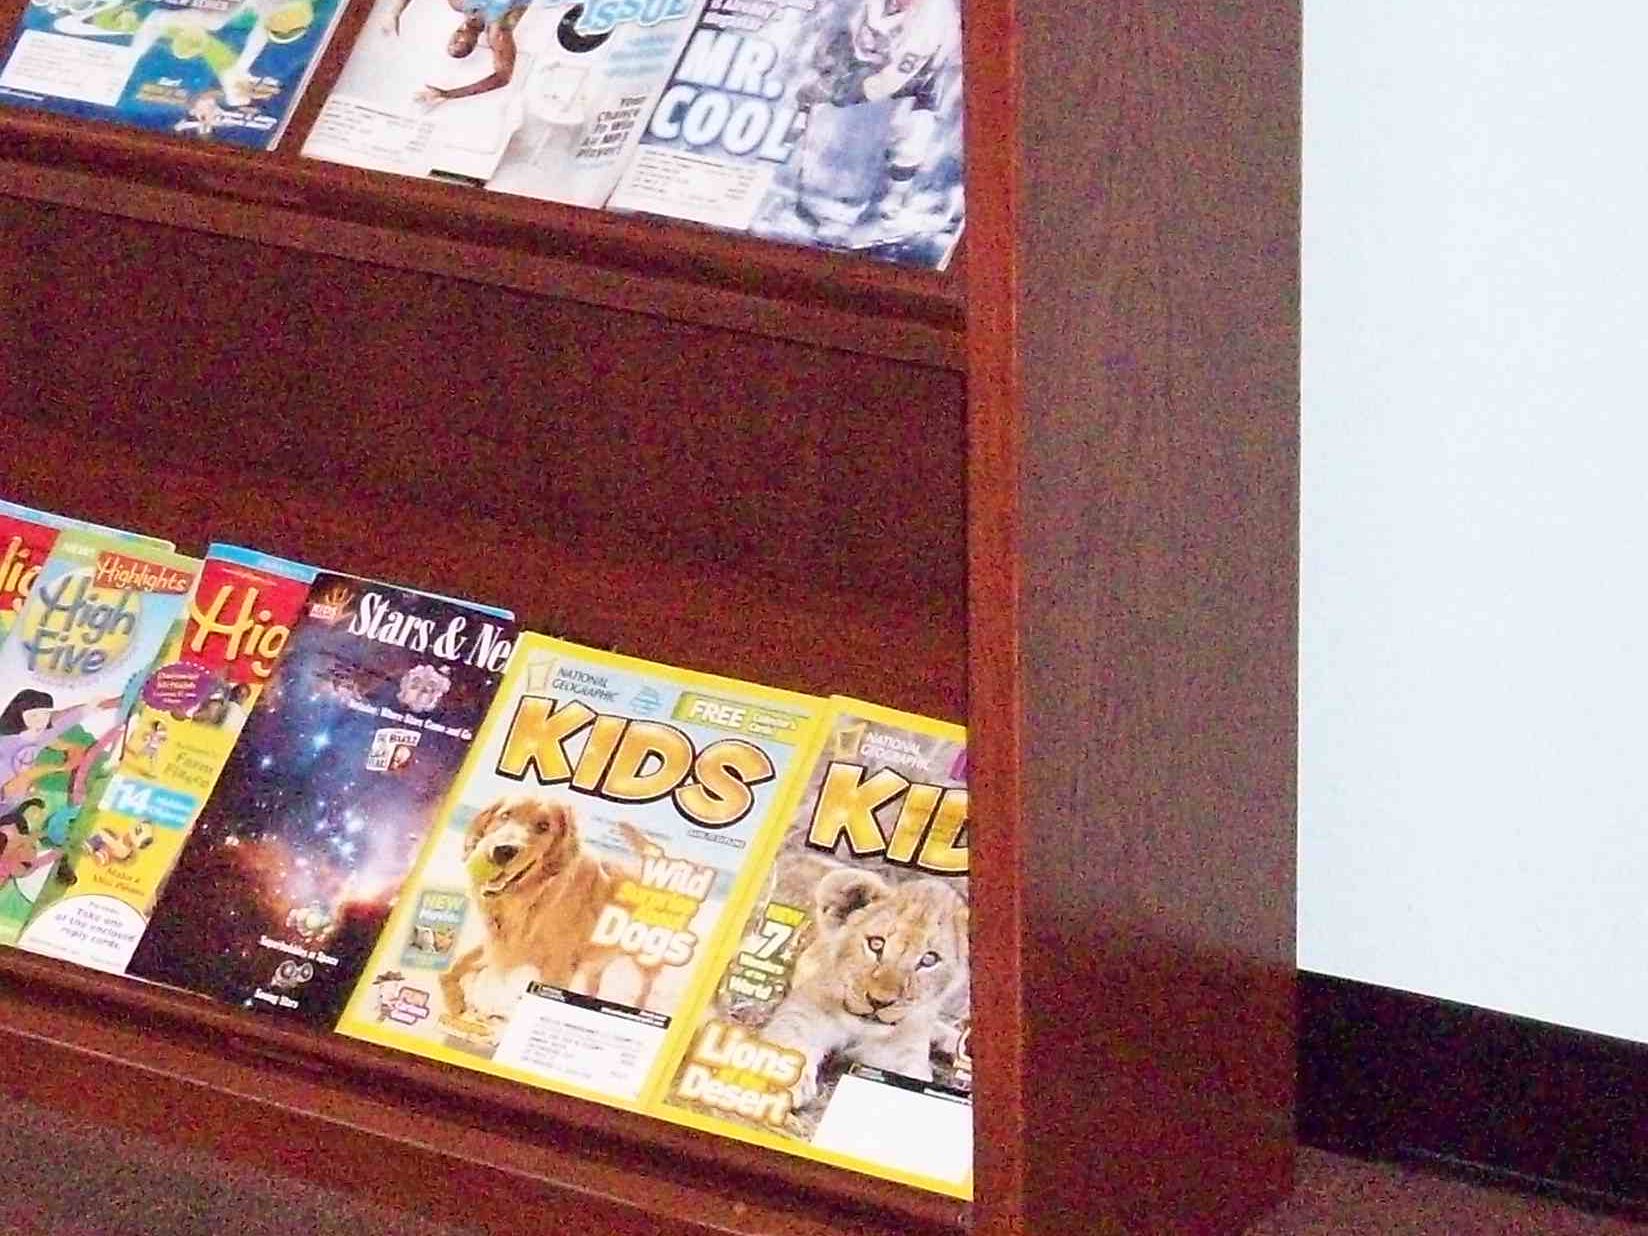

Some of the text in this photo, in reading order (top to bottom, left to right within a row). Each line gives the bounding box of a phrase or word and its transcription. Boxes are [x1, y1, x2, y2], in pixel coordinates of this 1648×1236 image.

[673, 28, 786, 101] MR.
[648, 84, 794, 166] COOL
[96, 556, 188, 592] Highlights
[38, 572, 137, 645] High
[348, 592, 437, 653] Stars
[433, 616, 468, 661] &
[24, 627, 109, 675] Five
[552, 678, 621, 703] GEOGRAPHIC
[558, 667, 609, 689] NATIONAL
[689, 699, 747, 729] FREE
[495, 694, 777, 830] KIDS
[860, 743, 930, 772] GEOGRAPHIC
[867, 731, 921, 754] NATIONAL
[641, 857, 718, 903] Wild
[591, 905, 699, 968] Dogs
[752, 920, 794, 960] 7
[699, 1018, 807, 1088] Lions
[676, 1063, 793, 1127] Desert
